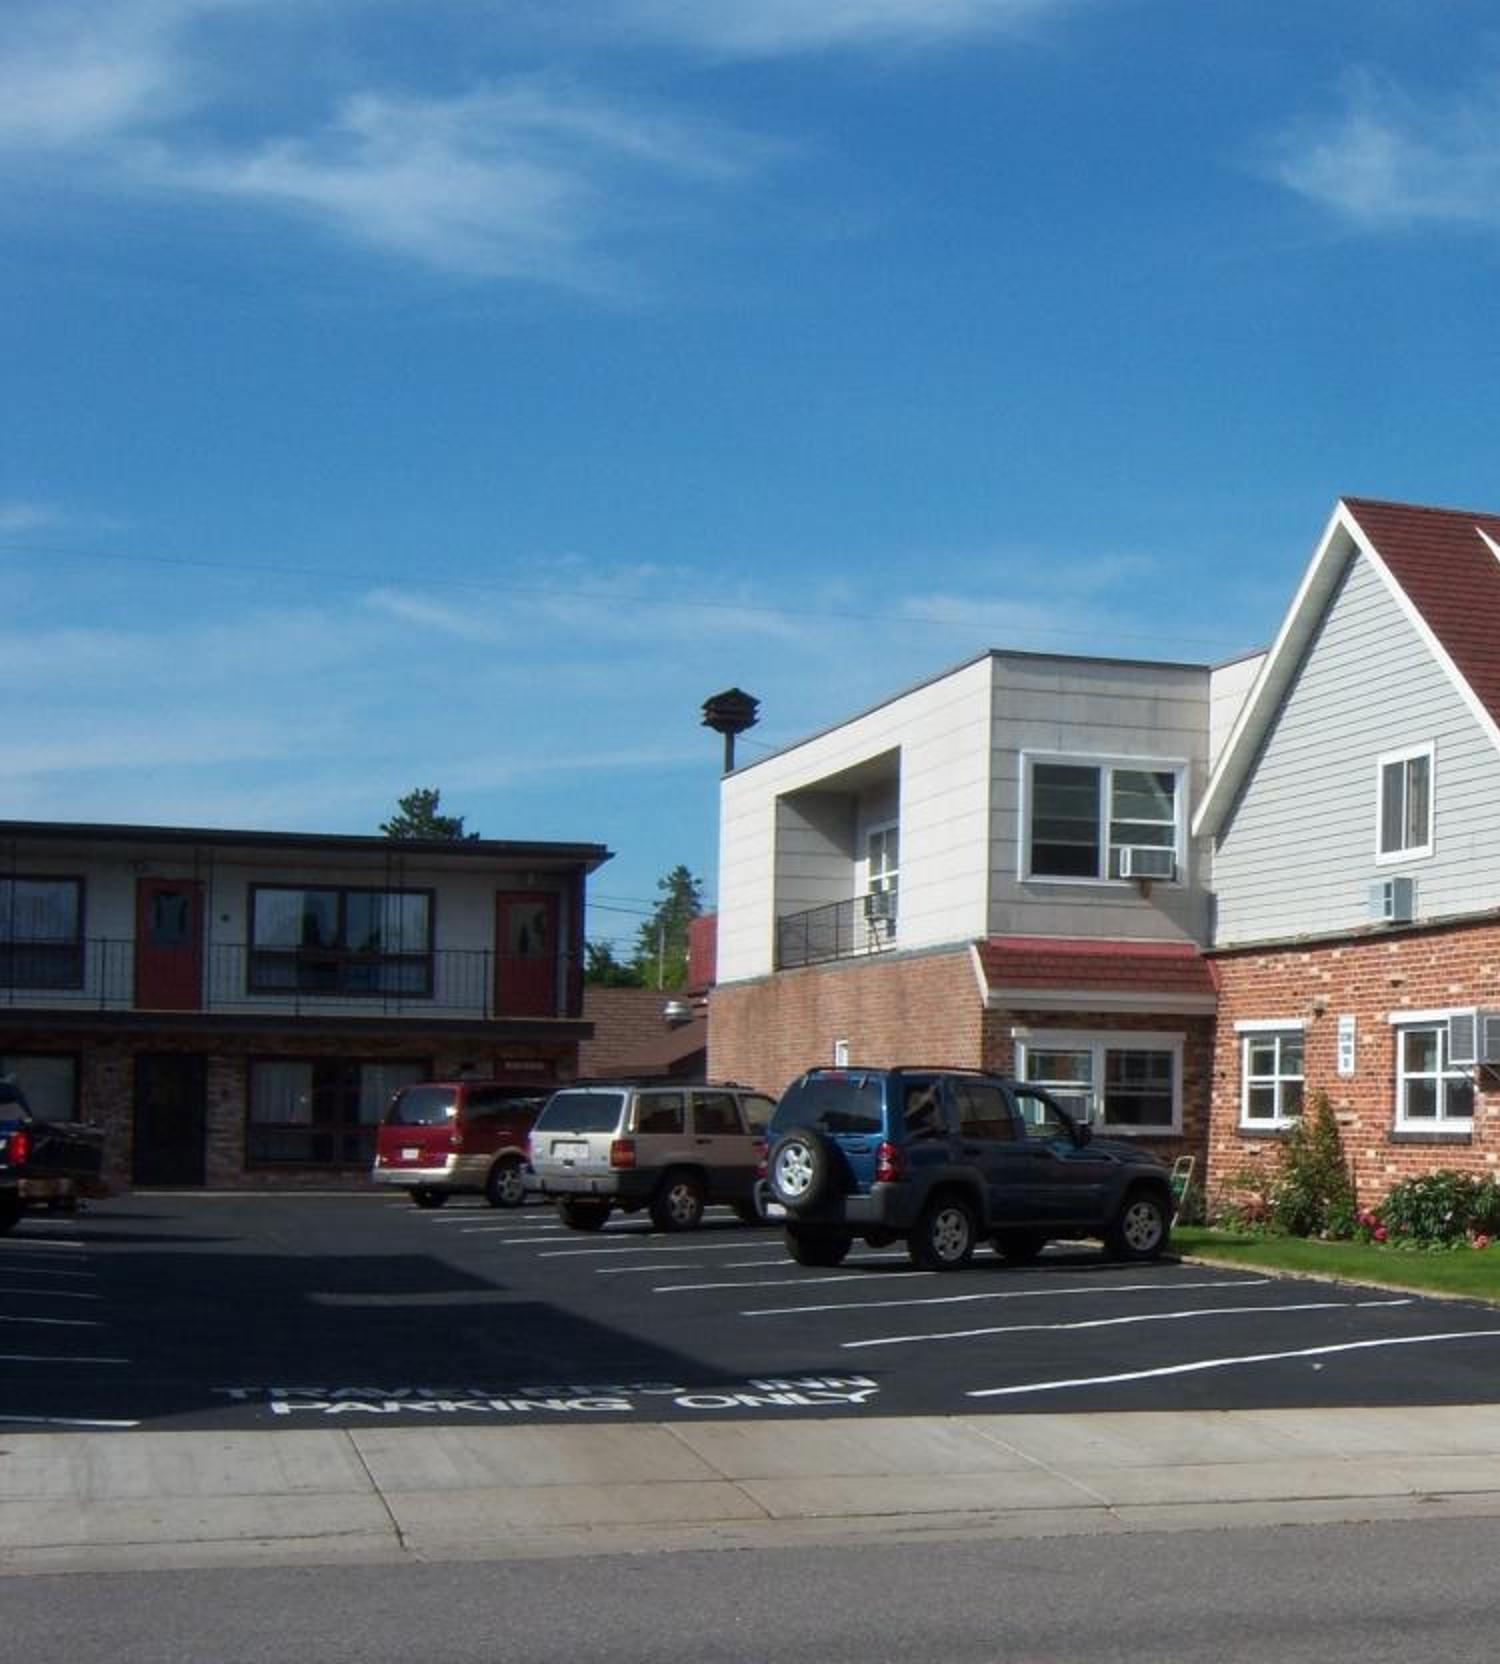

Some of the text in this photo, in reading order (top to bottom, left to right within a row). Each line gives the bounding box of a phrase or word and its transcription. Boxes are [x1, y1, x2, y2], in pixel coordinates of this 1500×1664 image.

[747, 1375, 879, 1391] INN
[269, 1388, 881, 1415] PARKING ONLY
